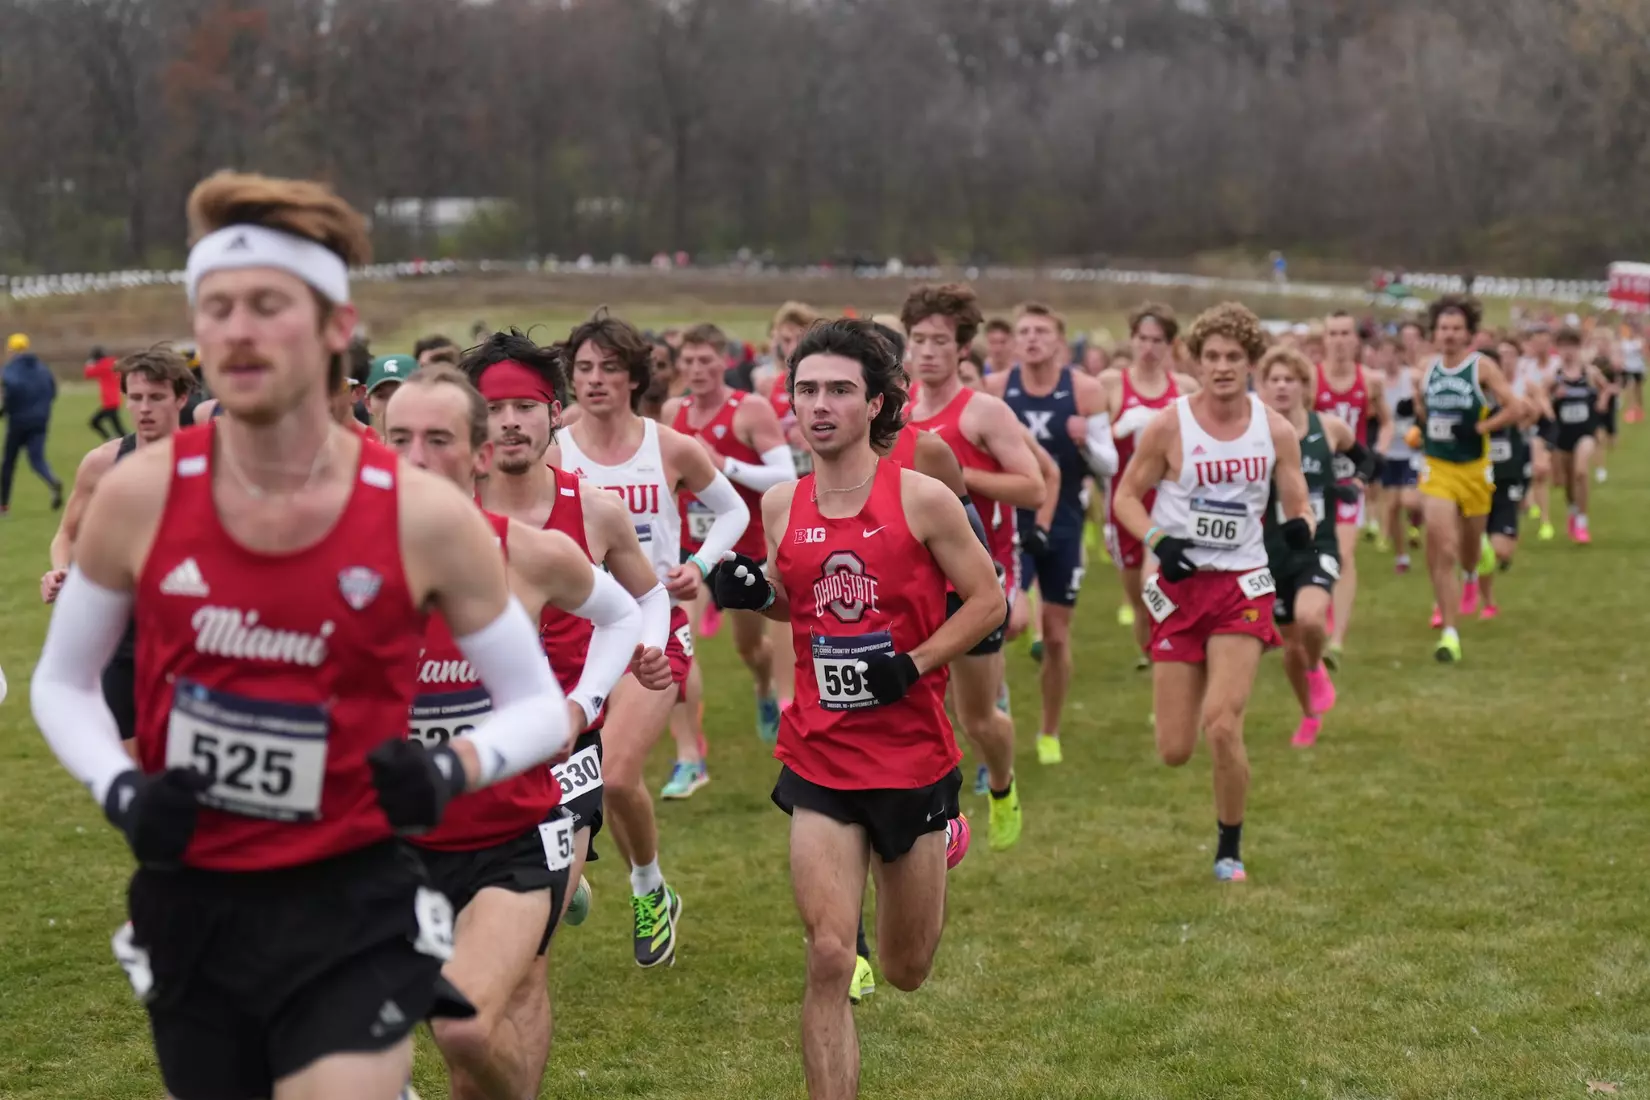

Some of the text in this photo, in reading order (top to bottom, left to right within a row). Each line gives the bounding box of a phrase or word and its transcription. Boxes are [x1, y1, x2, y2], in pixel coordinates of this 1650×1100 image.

[1194, 456, 1268, 487] IUPUI
[1196, 517, 1237, 540] 506
[813, 570, 880, 617] OHIO STATE
[191, 605, 335, 667] Miami
[851, 641, 892, 654] CHAMPIONSHIPS
[824, 665, 873, 696] 59
[191, 733, 294, 796] 525
[554, 755, 599, 795] 530
